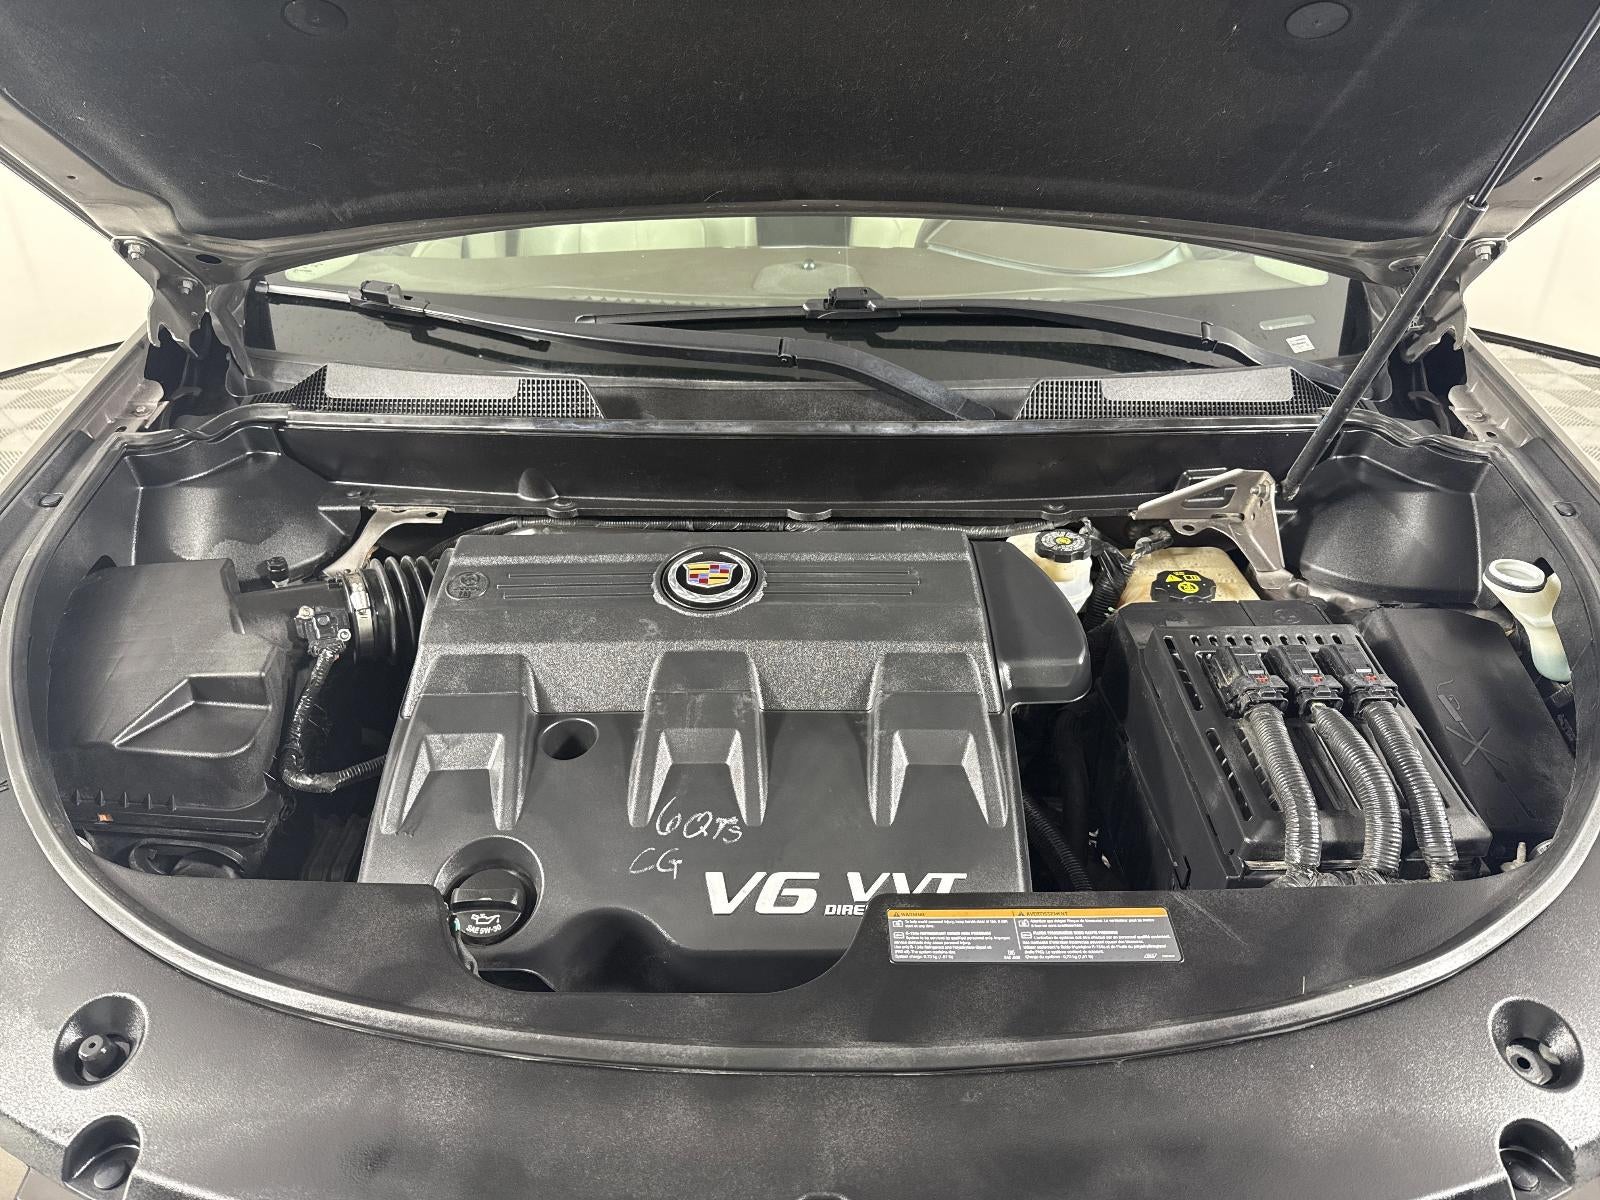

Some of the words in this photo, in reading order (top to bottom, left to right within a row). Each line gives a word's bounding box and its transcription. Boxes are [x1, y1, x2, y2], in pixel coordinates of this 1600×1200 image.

[705, 871, 821, 915] V6
[846, 871, 968, 902] VVT
[824, 904, 868, 917] DIRE
[466, 924, 479, 934] SAE
